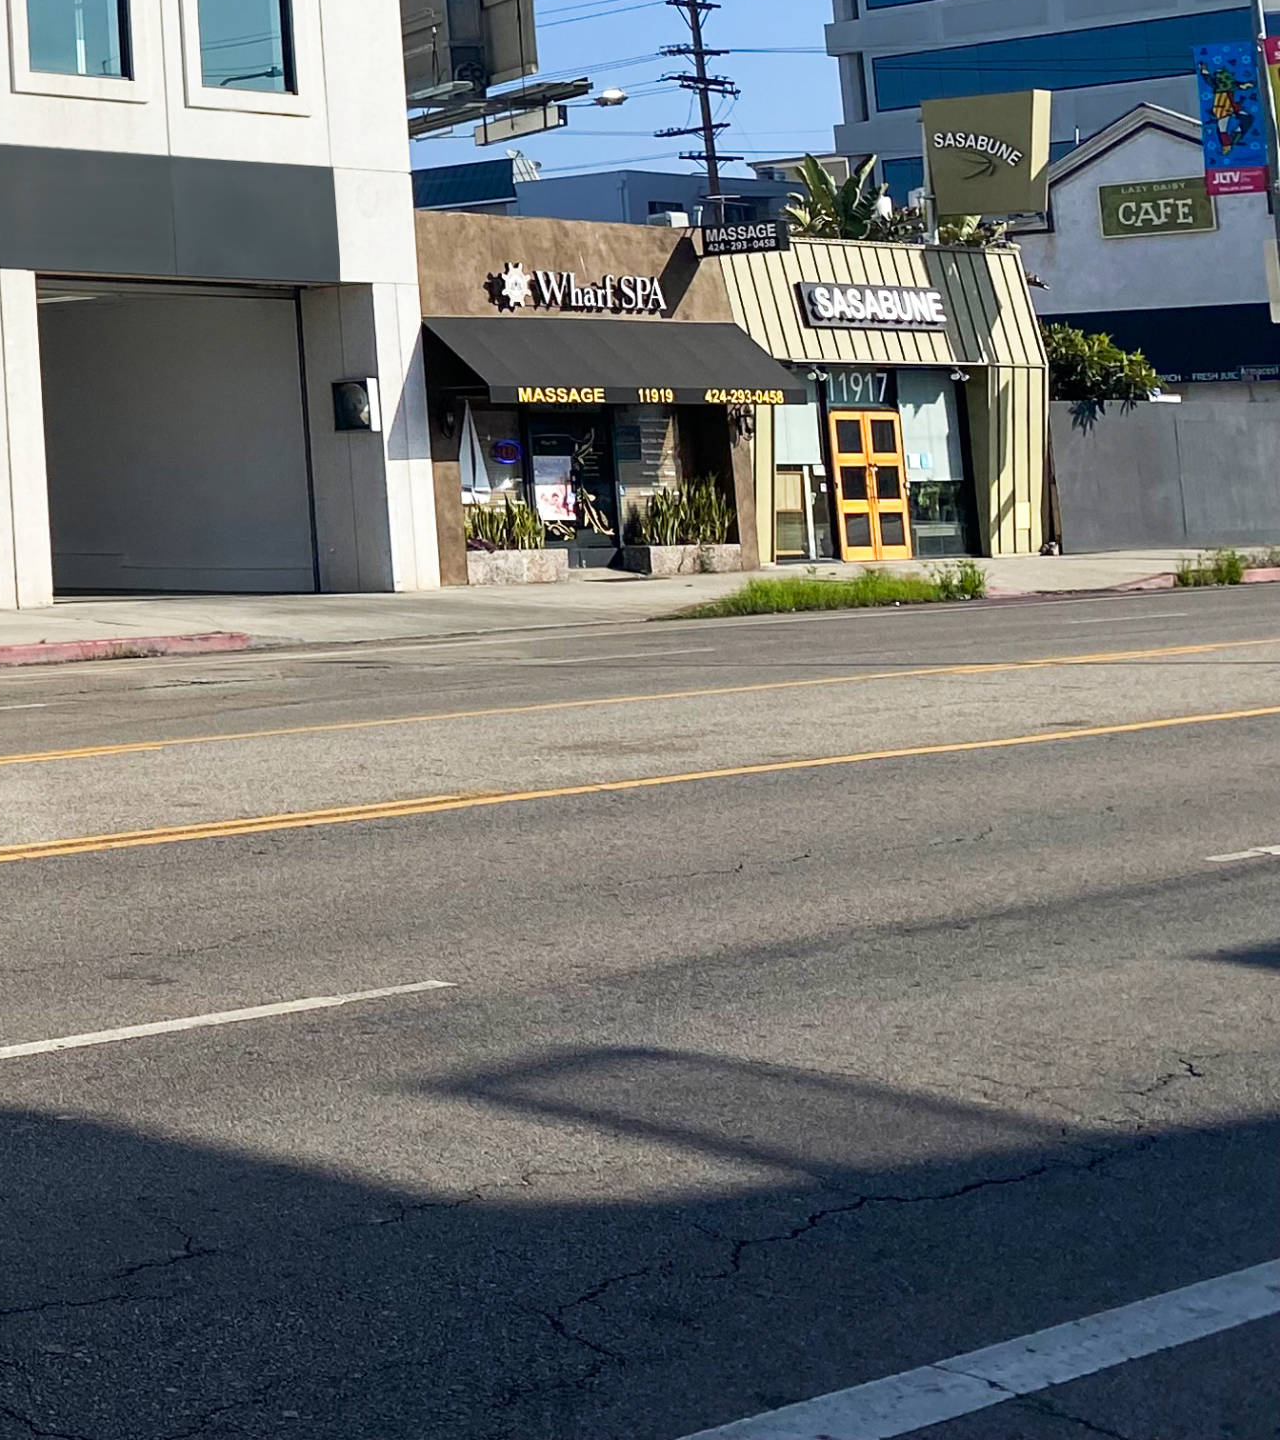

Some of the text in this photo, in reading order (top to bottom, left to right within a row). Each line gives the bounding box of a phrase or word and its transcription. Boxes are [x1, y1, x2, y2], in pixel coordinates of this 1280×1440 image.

[934, 132, 1023, 167] SASABUNE
[1153, 182, 1186, 192] DAISY
[1212, 171, 1241, 185] JLTV
[1118, 198, 1194, 227] CAFE
[705, 223, 777, 242] MASSAGE
[708, 238, 776, 252] 424-293-0458
[533, 270, 667, 311] Wharf SPA
[814, 286, 947, 322] SASABUNE
[1219, 371, 1240, 380] JUIC
[518, 387, 784, 404] MASSAGE 11919 424-293-0458
[827, 372, 888, 403] 11917
